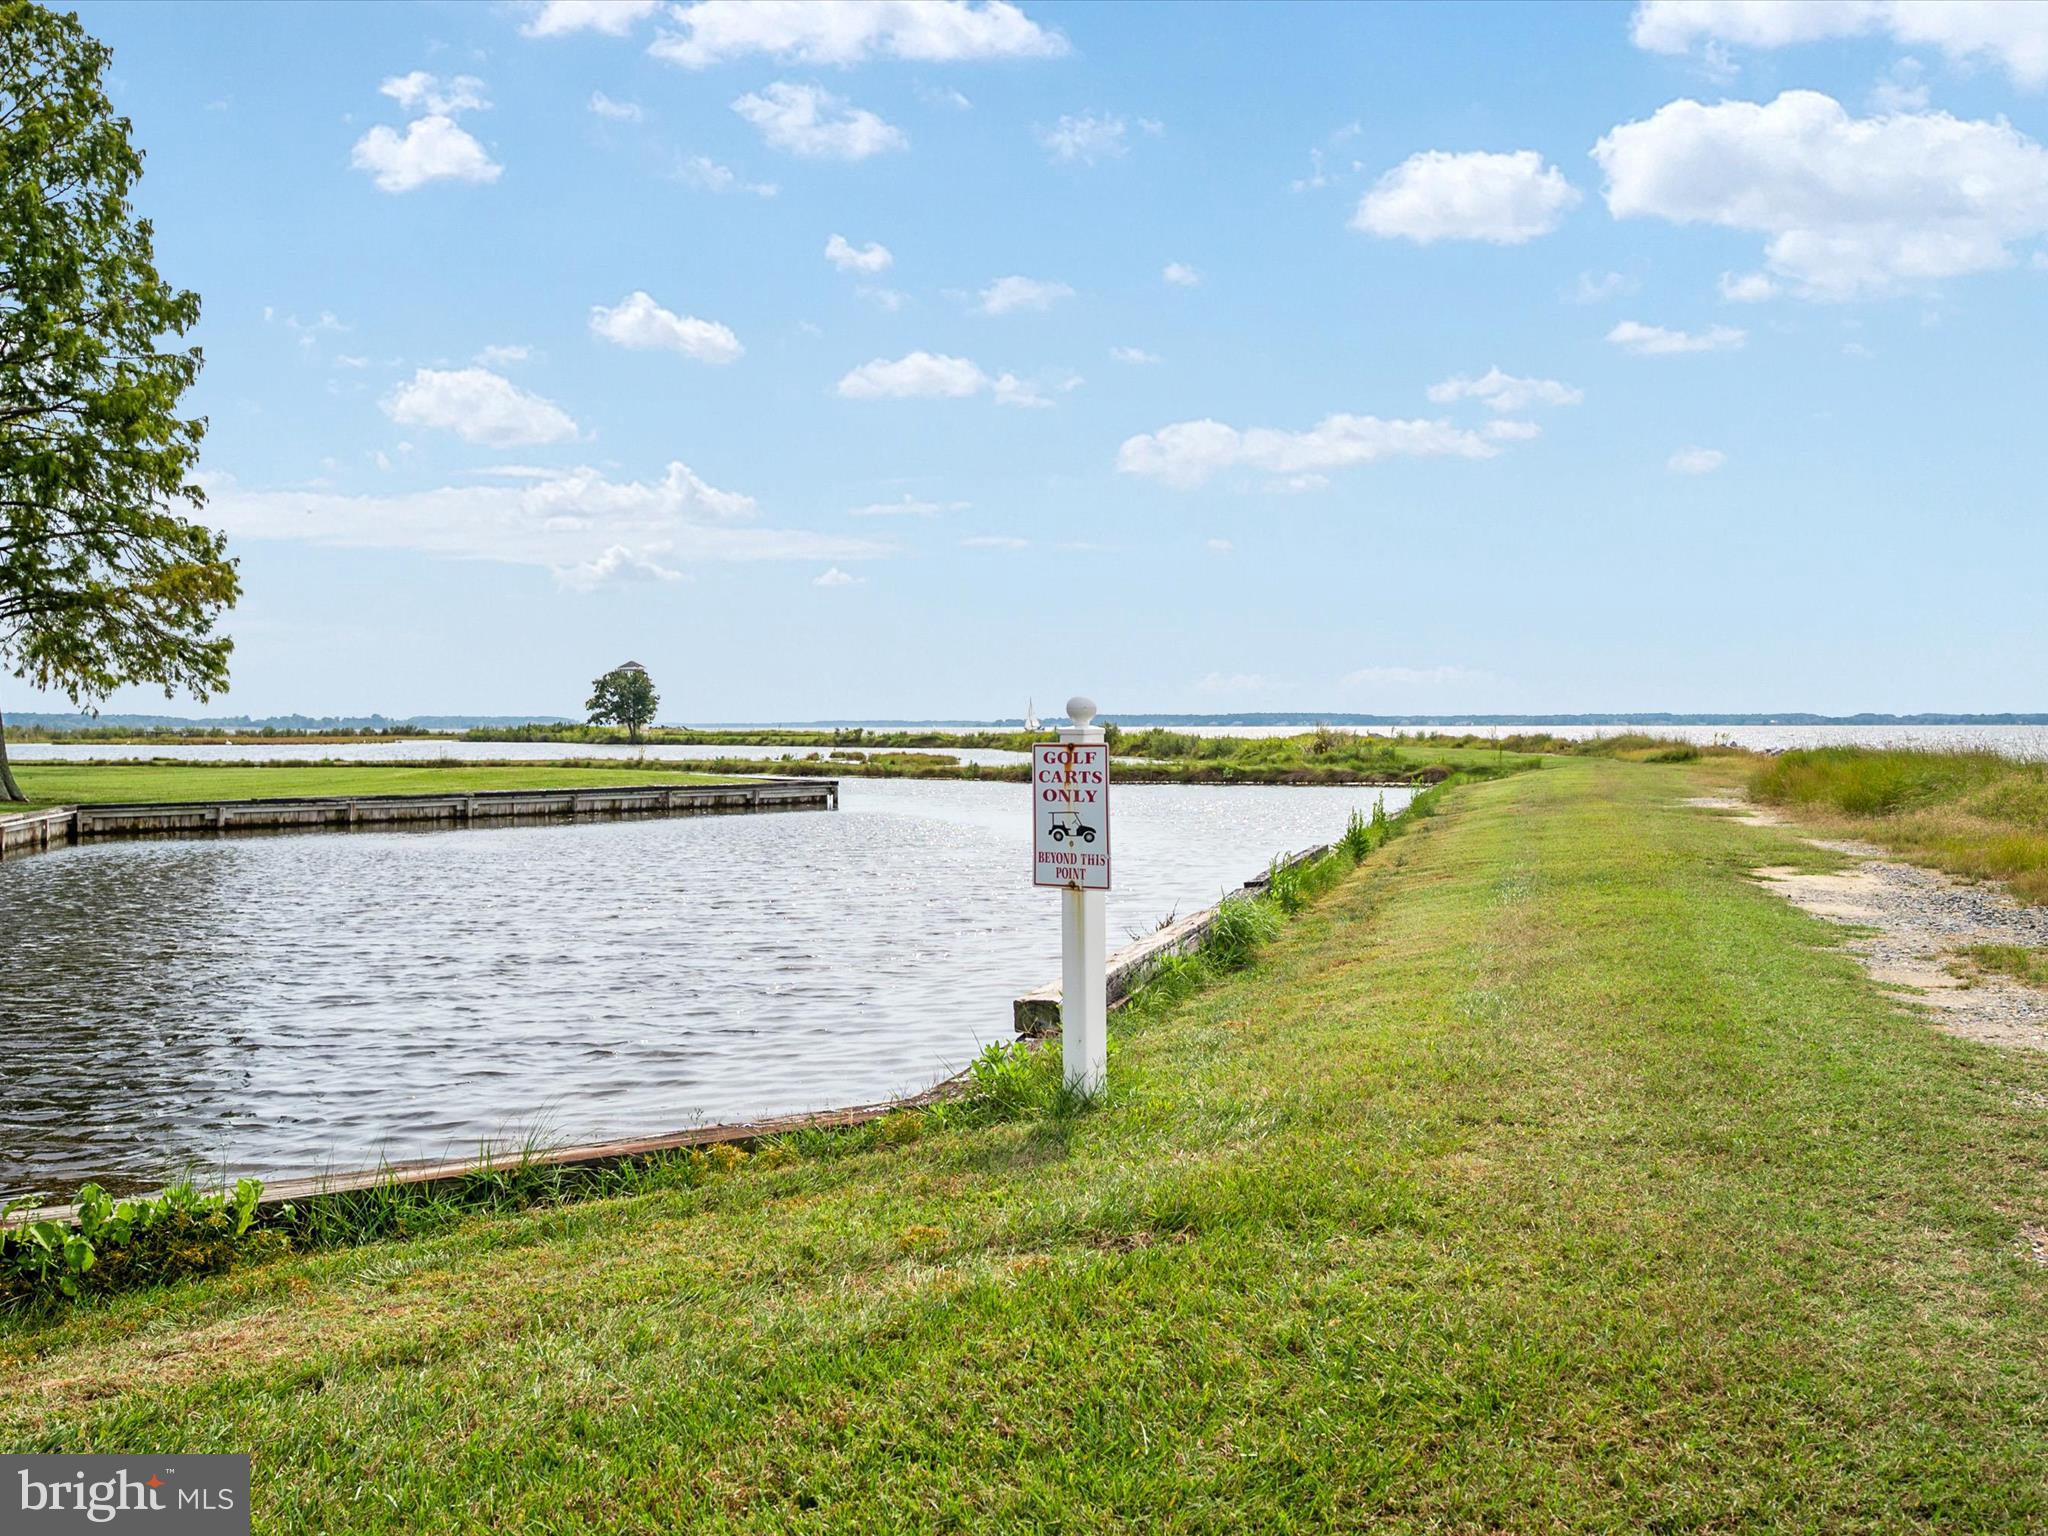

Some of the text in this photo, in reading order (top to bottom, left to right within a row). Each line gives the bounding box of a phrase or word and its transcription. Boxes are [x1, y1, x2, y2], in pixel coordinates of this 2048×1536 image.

[1043, 751, 1097, 764] GOLF
[1039, 770, 1102, 784] CARTS
[1042, 789, 1098, 803] ONLY
[1038, 851, 1105, 866] BEYOND THIS
[1055, 867, 1086, 880] POINT
